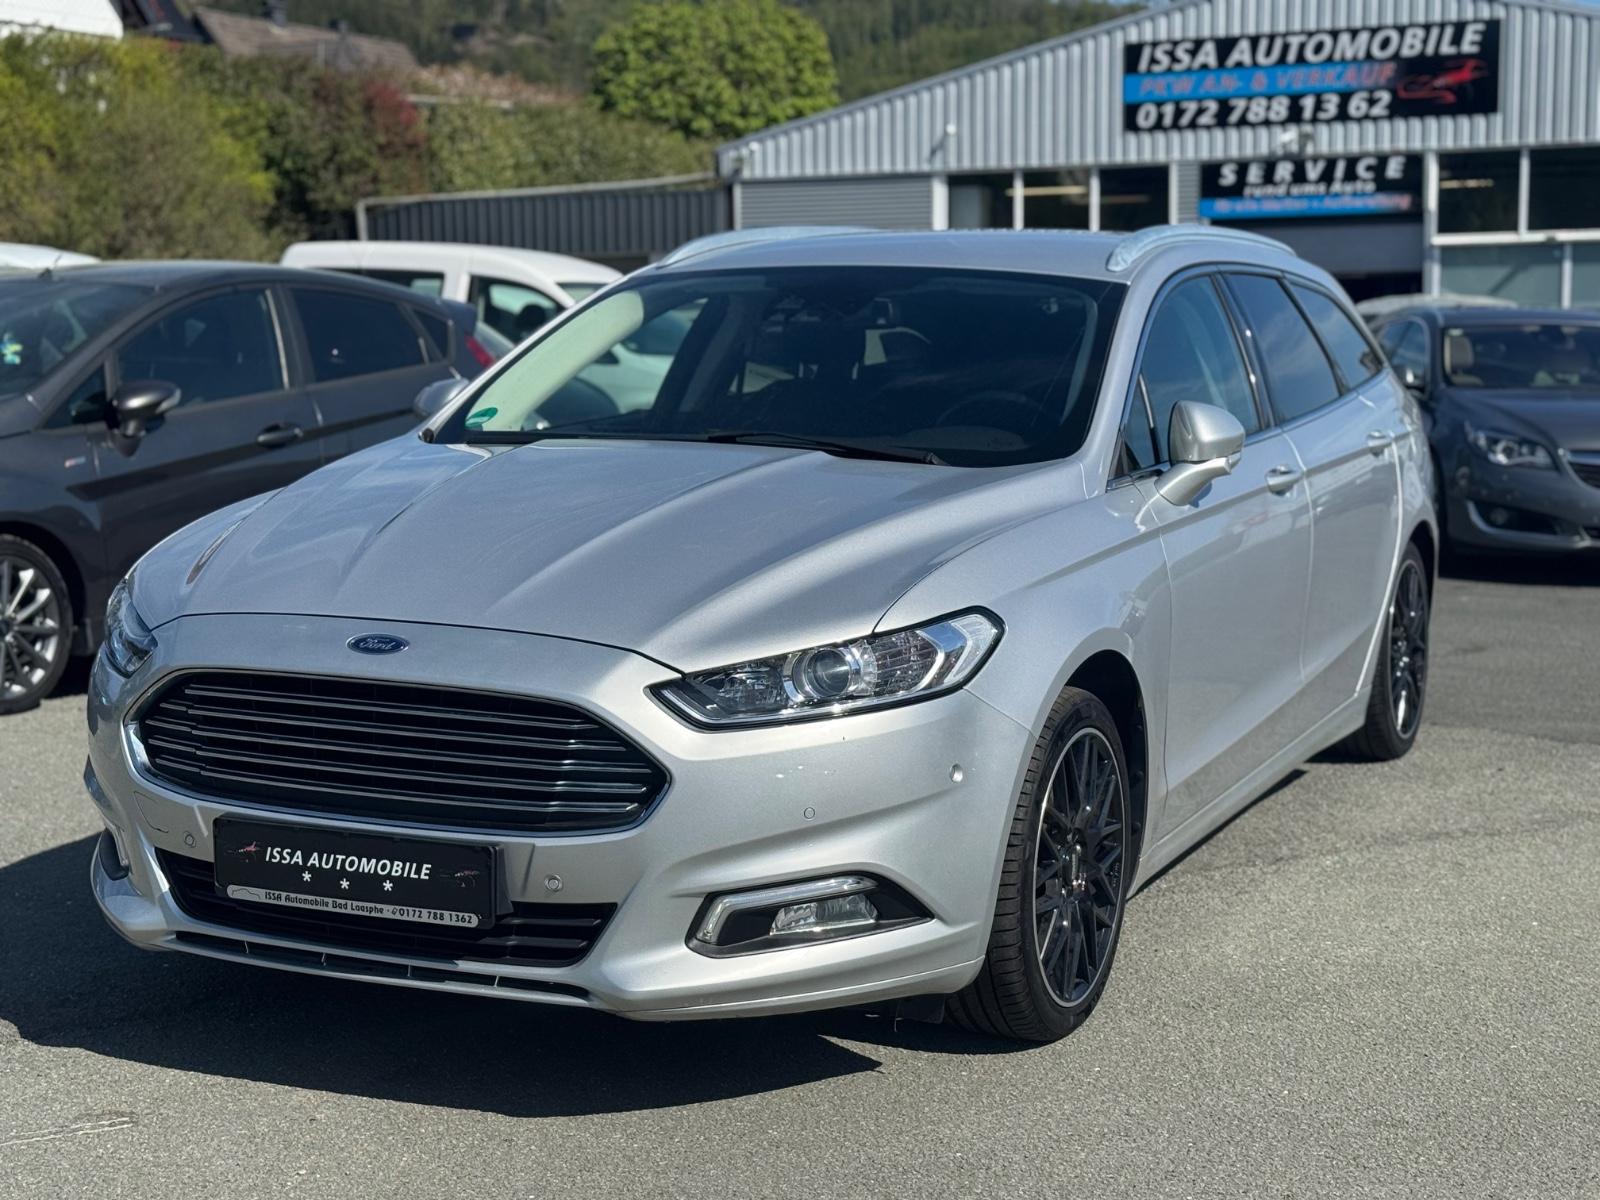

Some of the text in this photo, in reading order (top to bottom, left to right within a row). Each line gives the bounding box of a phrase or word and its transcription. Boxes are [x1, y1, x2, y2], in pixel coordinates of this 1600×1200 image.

[1137, 22, 1486, 73] ISSA AUTOMOBILE
[1140, 75, 1194, 96] PKW
[1251, 71, 1268, 91] &
[1277, 62, 1396, 88] VERKAUF
[1135, 89, 1392, 129] 0172 788 13 62
[1218, 155, 1406, 186] SERVICE
[1289, 181, 1327, 196] ums
[1329, 179, 1377, 195] Auto
[265, 846, 432, 880] ISSA AUTOMOBILE
[265, 891, 473, 924] ISSA Automobile Bad Laasphe 0172 788 1362
